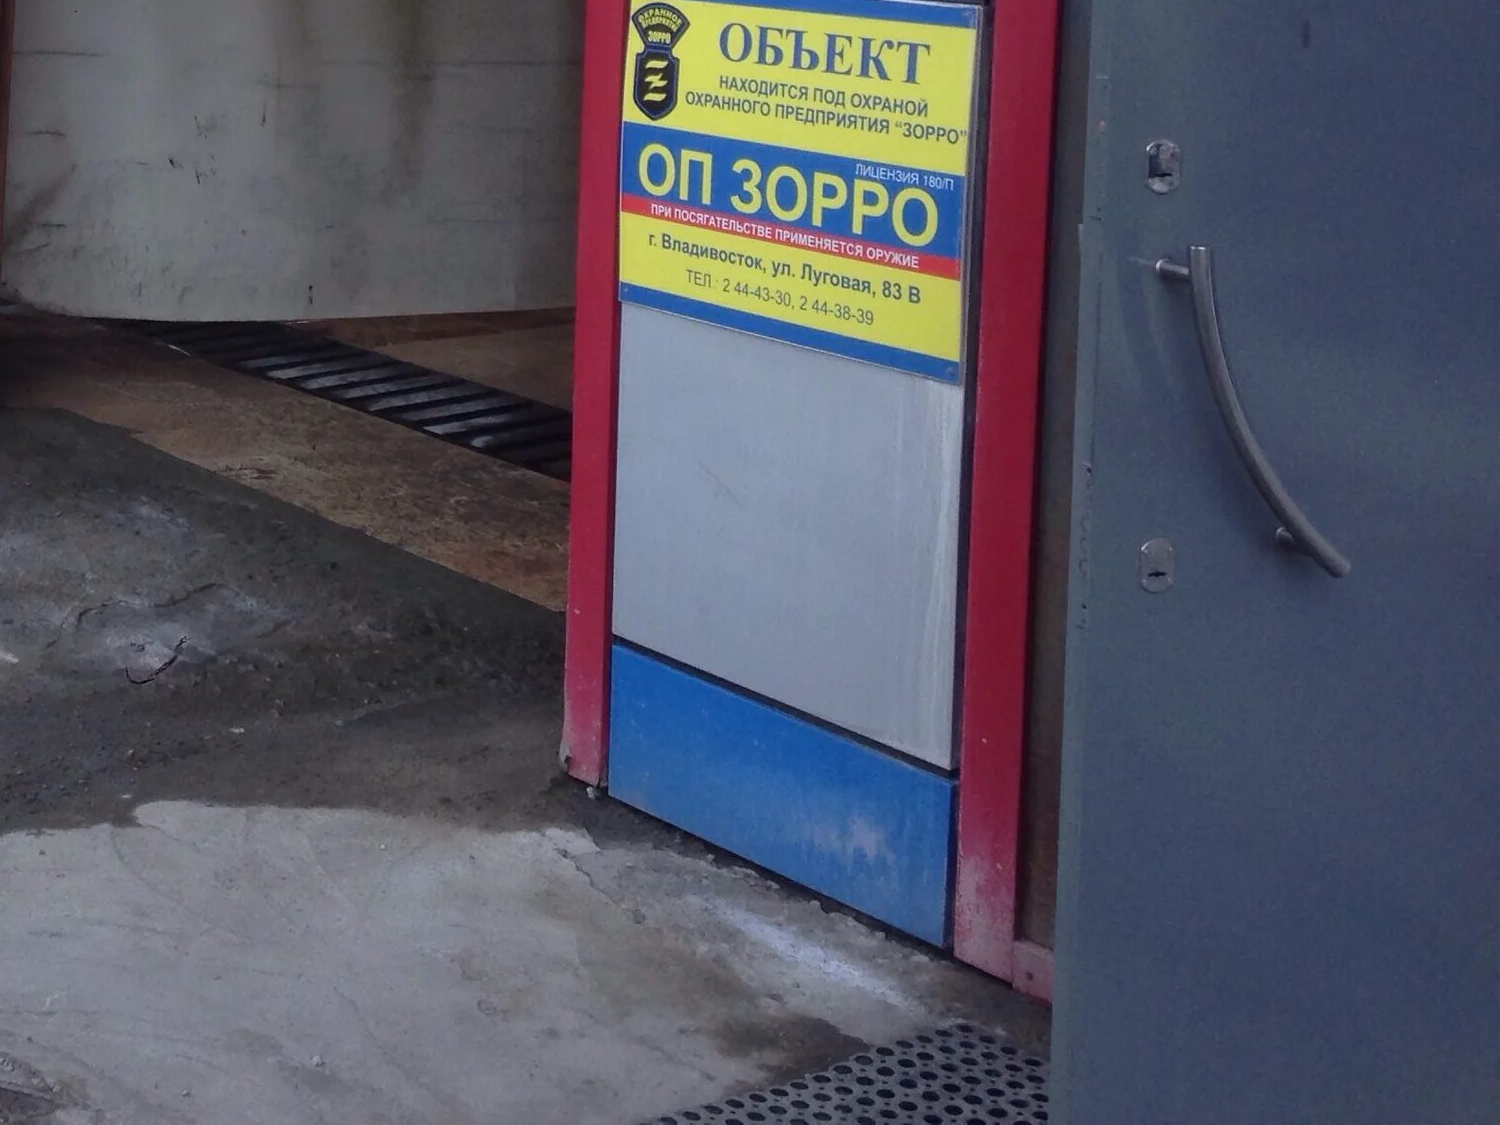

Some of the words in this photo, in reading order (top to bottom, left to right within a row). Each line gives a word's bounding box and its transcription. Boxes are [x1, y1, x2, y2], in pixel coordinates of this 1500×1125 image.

[718, 22, 931, 85] ОБЪЕКТ
[685, 91, 771, 117] ОХРАННОГО
[774, 103, 890, 135] ПРЕДПРИЯТИЯ
[719, 75, 809, 101] НАХОДИТСЯ
[813, 87, 847, 109] ПОД
[850, 93, 929, 118] ОХРАНОЙ
[638, 143, 713, 207] ОП
[730, 158, 939, 248] ЗОРРО
[855, 163, 920, 186] ЛИЦЕНЗИЯ
[651, 203, 672, 219] ПРИ
[674, 207, 772, 240] ПОСЯГАТЕЛЬСТВЕ
[775, 228, 864, 257] ПРИМЕНЯЕТСЯ
[866, 246, 920, 269] ОРУЖИЕ
[661, 233, 767, 273] Владивосток,
[771, 259, 796, 279] ул.
[800, 264, 877, 298] Луговая,
[882, 280, 903, 301] 83
[908, 285, 922, 305] В
[722, 277, 731, 294] 2
[799, 294, 808, 311] 2
[811, 297, 875, 326] 44-38-39
